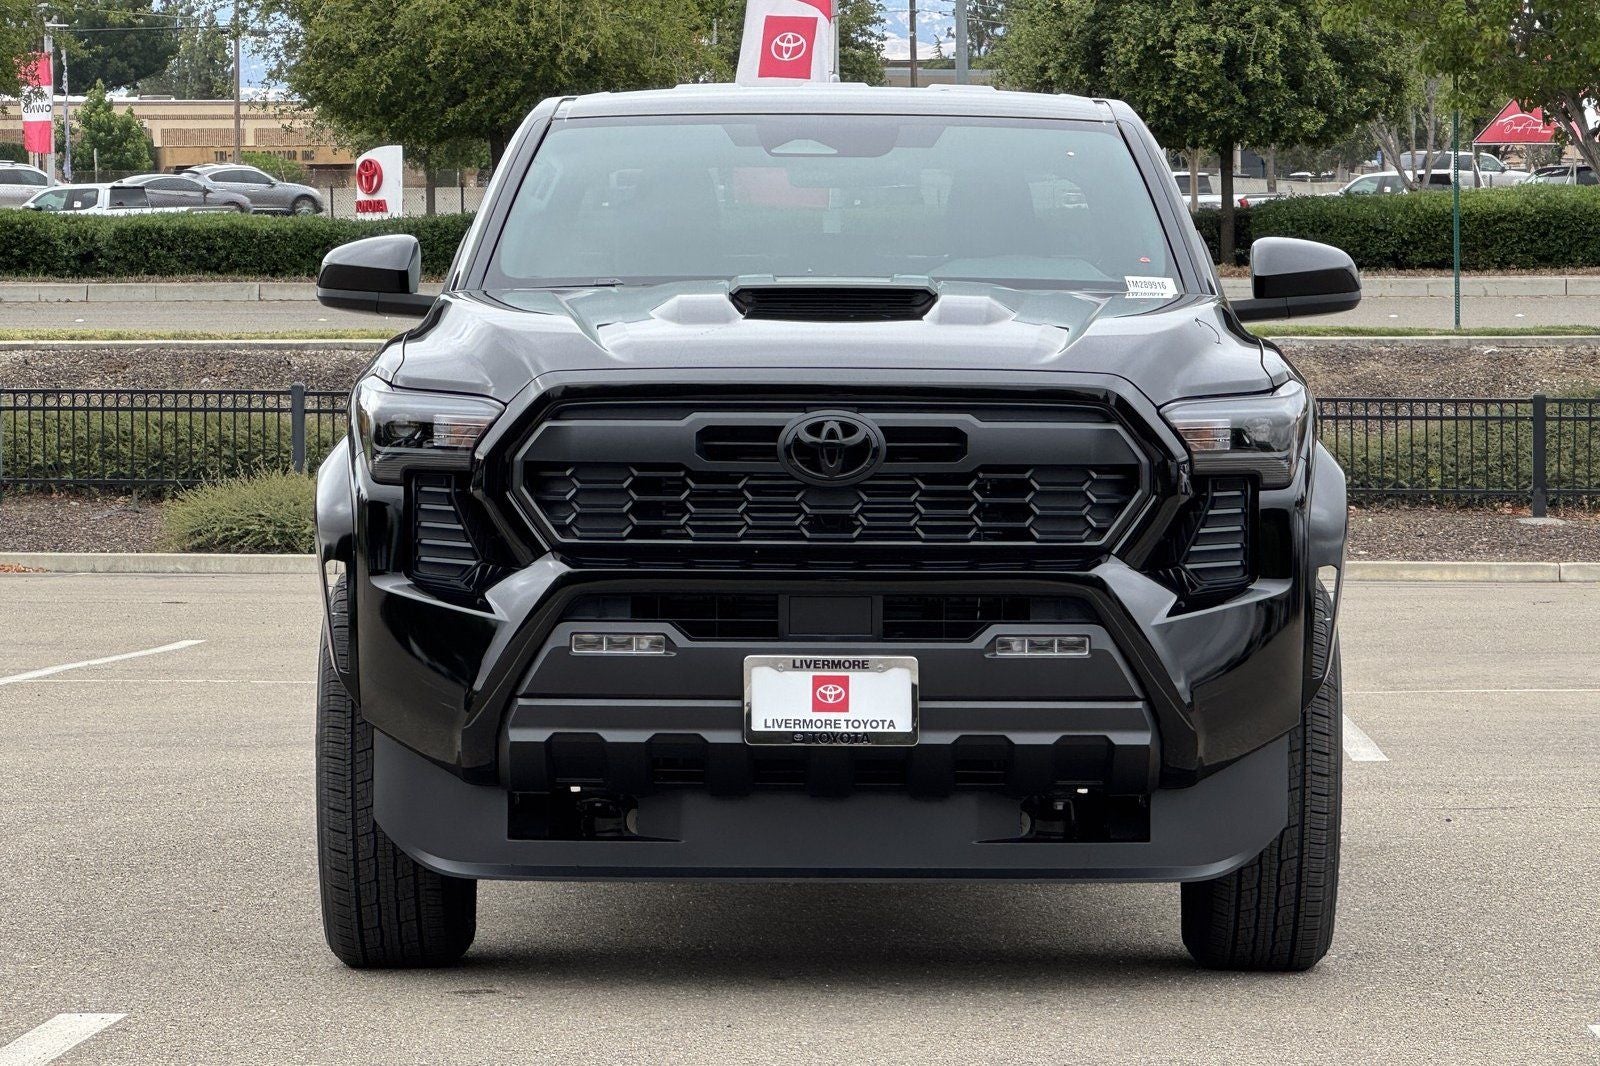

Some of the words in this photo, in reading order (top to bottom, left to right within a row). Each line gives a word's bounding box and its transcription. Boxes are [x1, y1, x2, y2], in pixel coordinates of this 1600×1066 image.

[301, 150, 315, 161] INC
[792, 659, 870, 670] LIVERMORE
[764, 718, 842, 729] LIVERMORE
[843, 719, 896, 730] TOYOTA
[807, 731, 872, 745] TOYOTA
